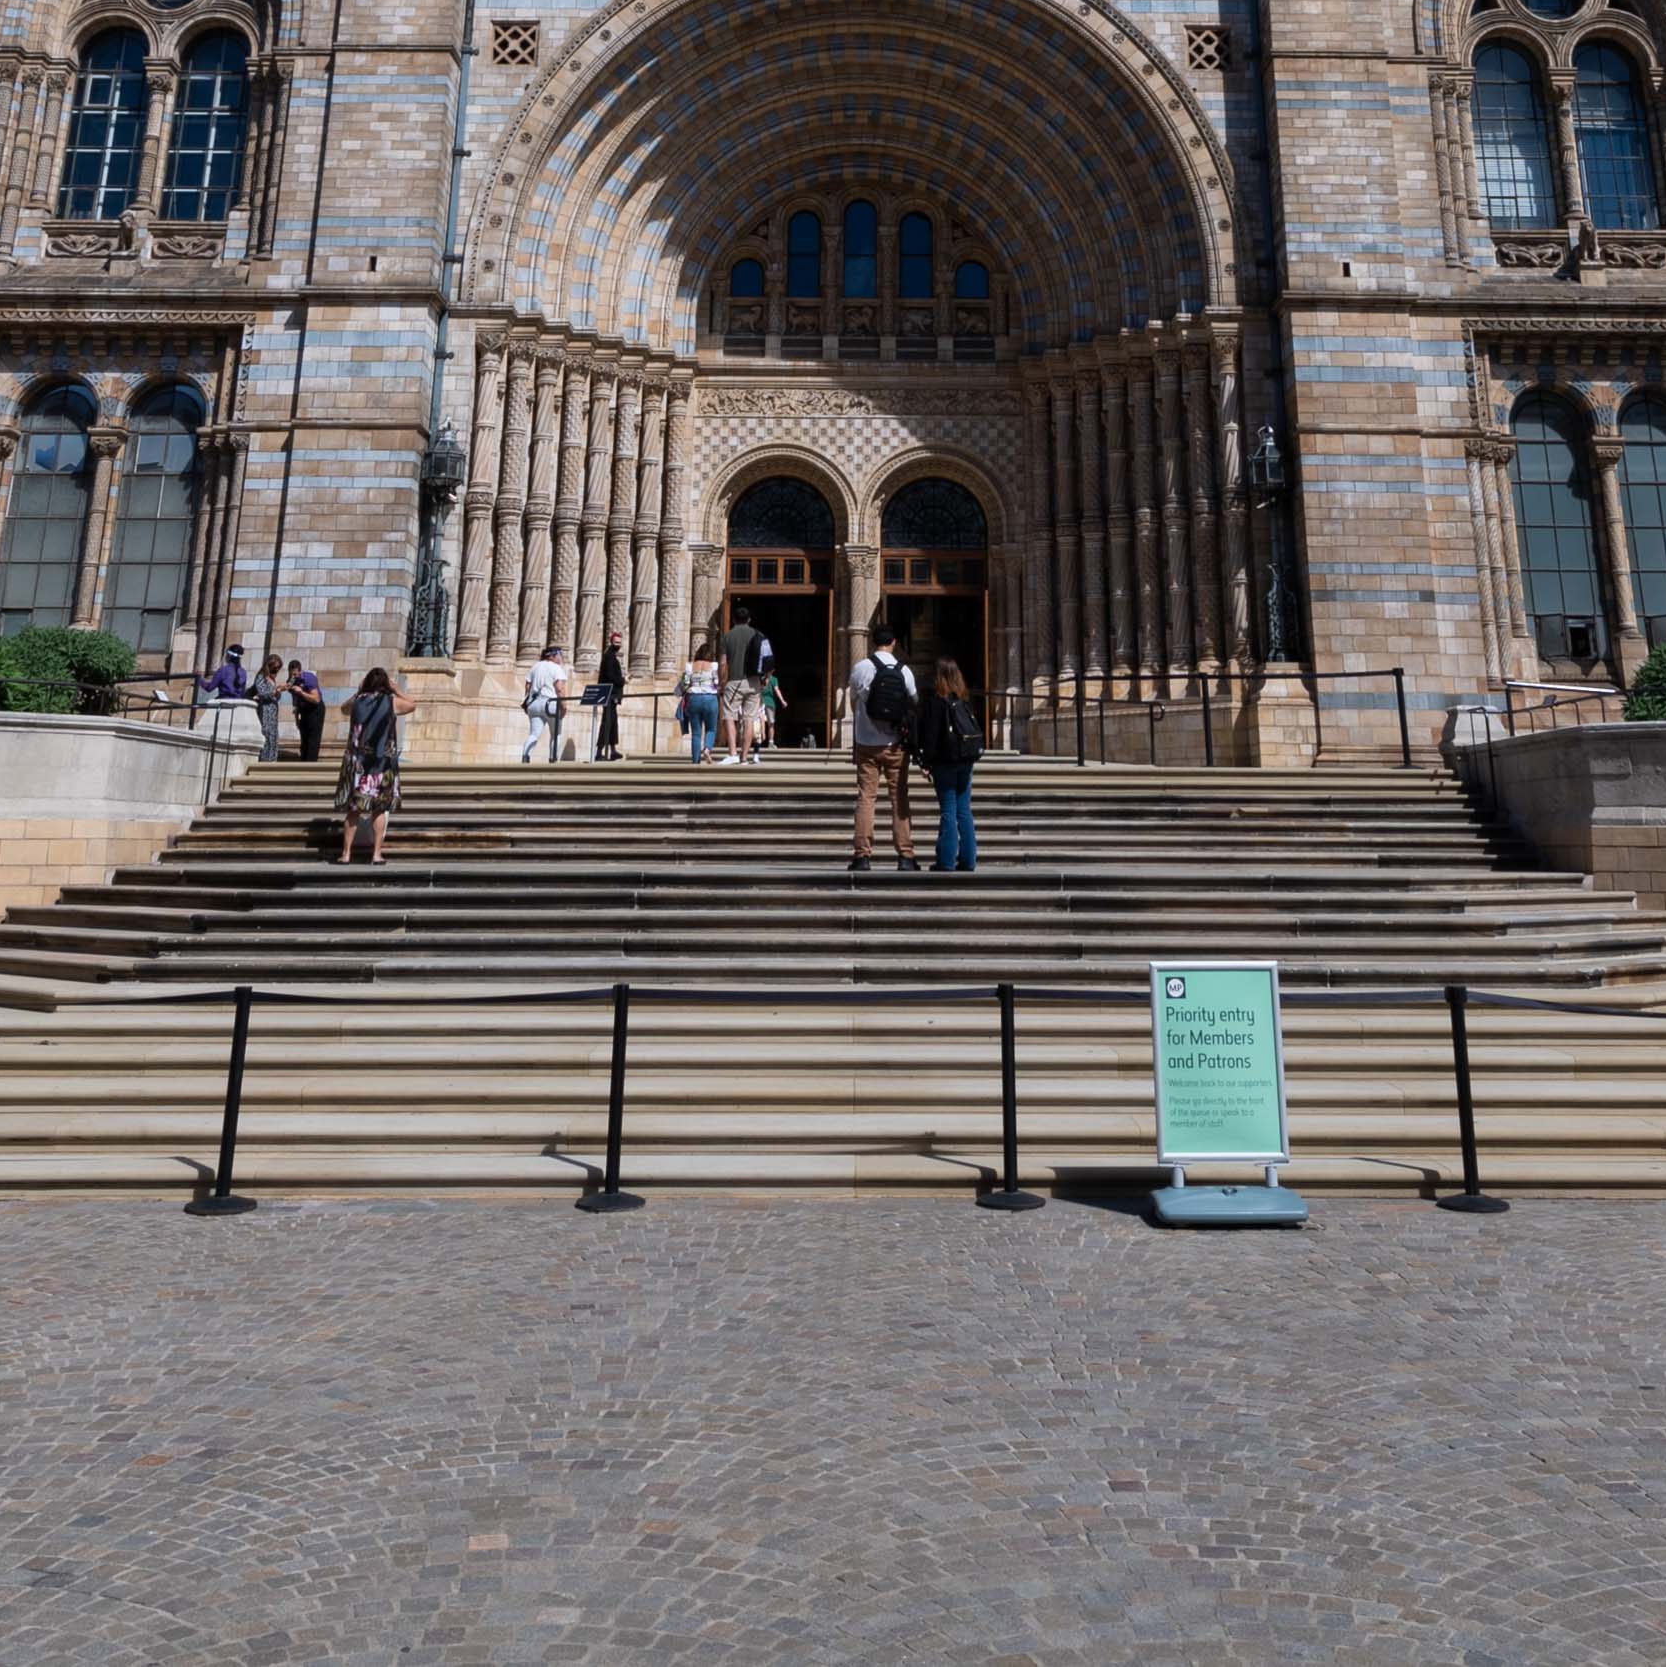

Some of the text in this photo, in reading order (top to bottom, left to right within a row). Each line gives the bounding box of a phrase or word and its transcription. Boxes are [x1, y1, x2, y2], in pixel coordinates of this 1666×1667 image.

[1169, 984, 1183, 992] MP
[1166, 1006, 1255, 1026] Priority entry
[1167, 1029, 1254, 1045] for Members
[1168, 1053, 1252, 1069] and Patrons
